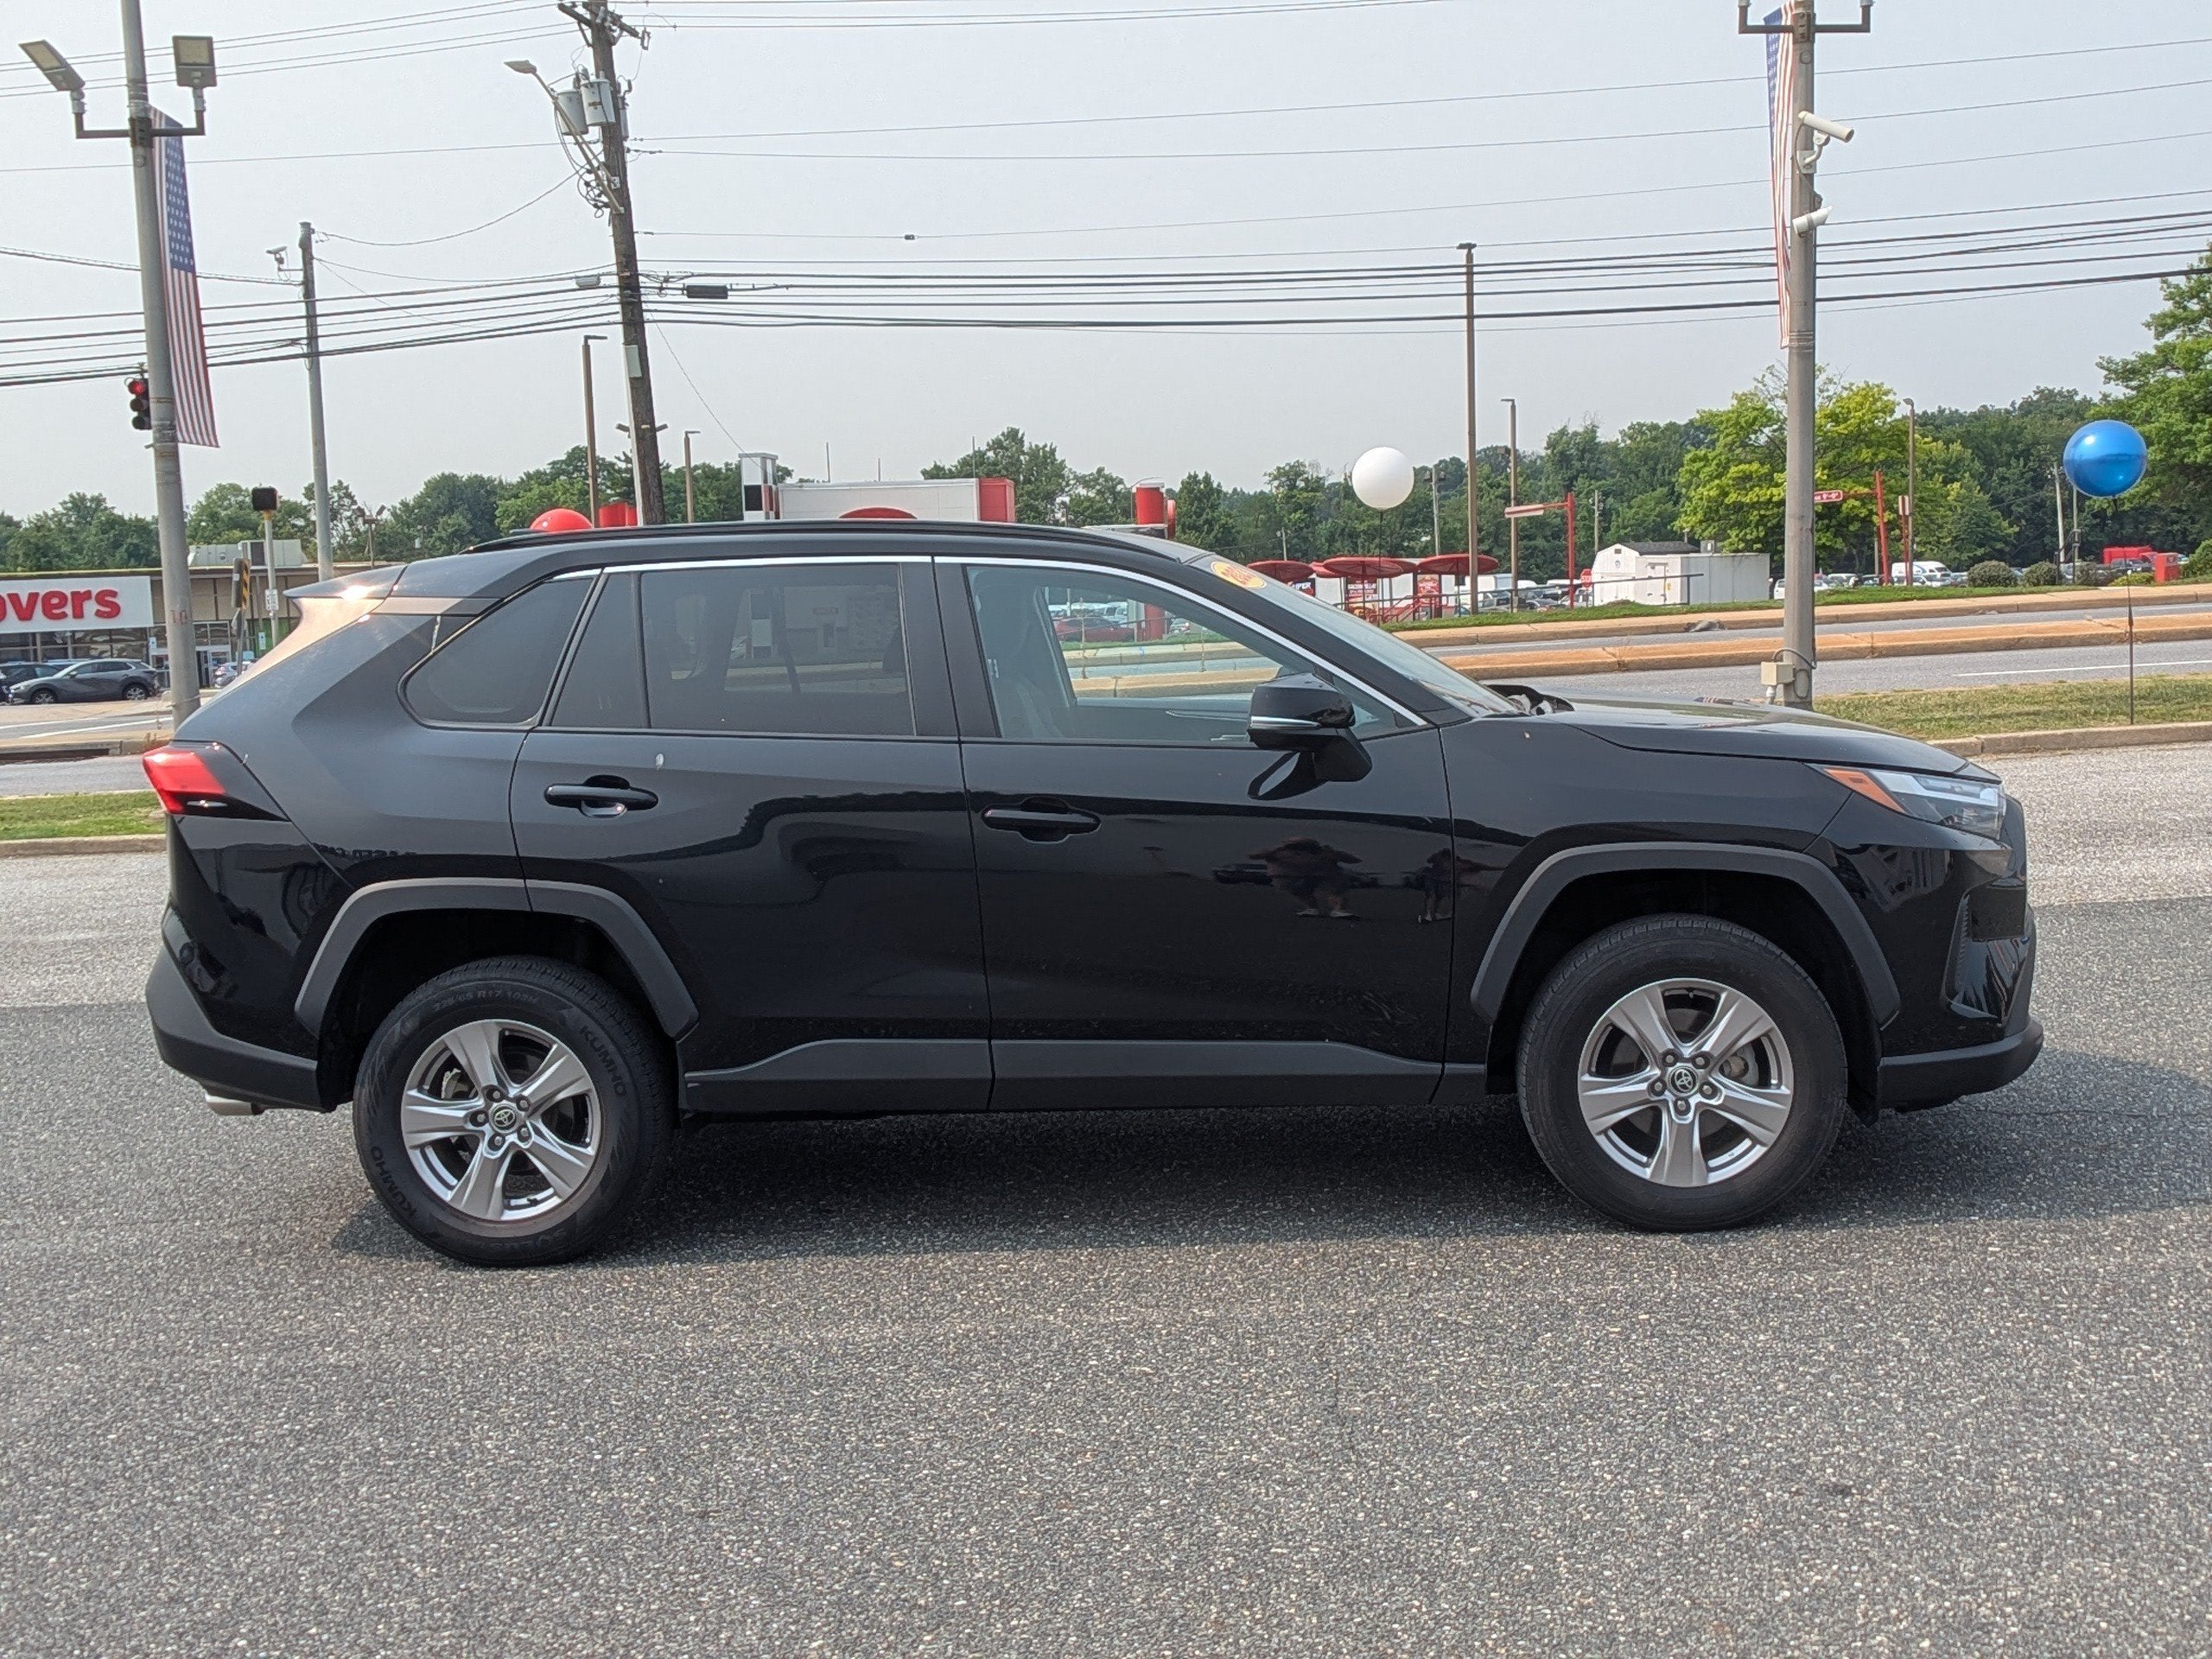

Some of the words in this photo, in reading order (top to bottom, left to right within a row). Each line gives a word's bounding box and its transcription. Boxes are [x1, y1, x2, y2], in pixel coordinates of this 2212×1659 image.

[0, 588, 121, 622] vers
[580, 1025, 627, 1096] KUMHO
[371, 1146, 417, 1217] KUMHO
